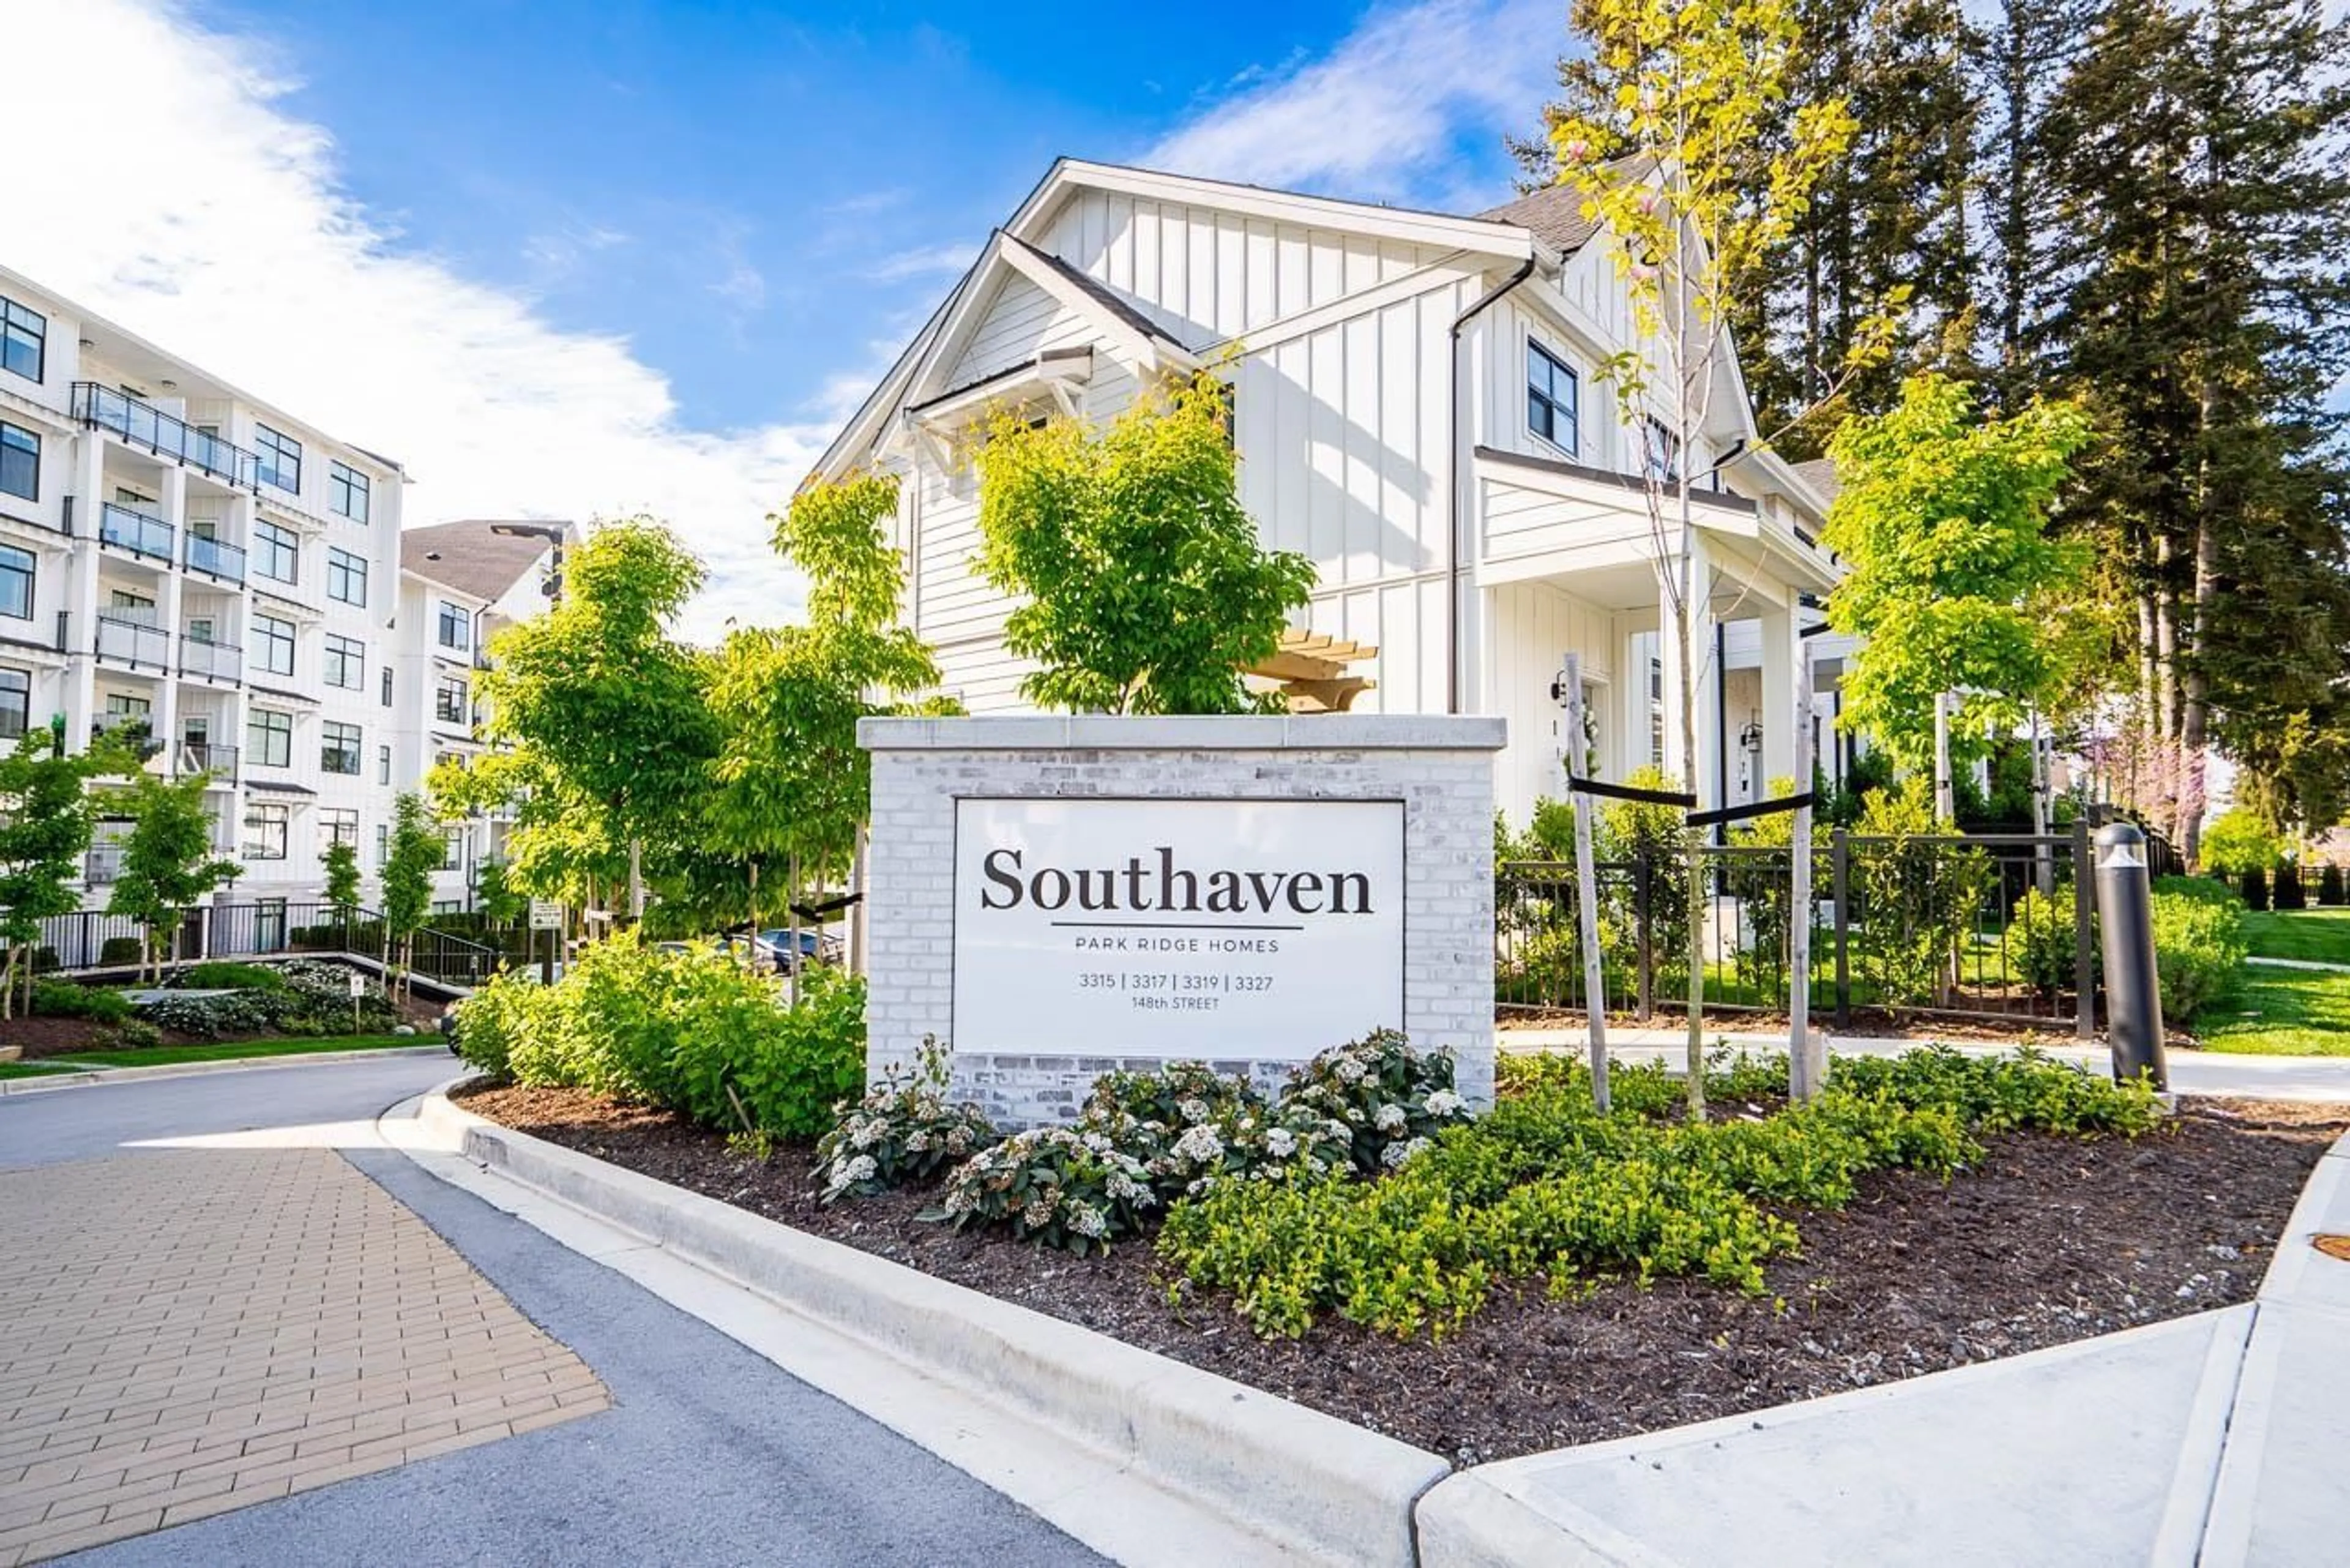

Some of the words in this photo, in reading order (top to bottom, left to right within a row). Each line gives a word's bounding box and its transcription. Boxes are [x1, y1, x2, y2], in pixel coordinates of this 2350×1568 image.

[982, 847, 1375, 914] Southaven
[1075, 937, 1127, 950] PARK
[1138, 938, 1199, 952] RIDGE
[1210, 940, 1279, 954] HOMES
[1080, 973, 1115, 988] 3315
[1132, 974, 1167, 989] 3317
[1183, 974, 1218, 990] 3319
[1235, 976, 1273, 991] 3327
[1133, 997, 1168, 1009] 148th
[1173, 998, 1219, 1010] STREET
